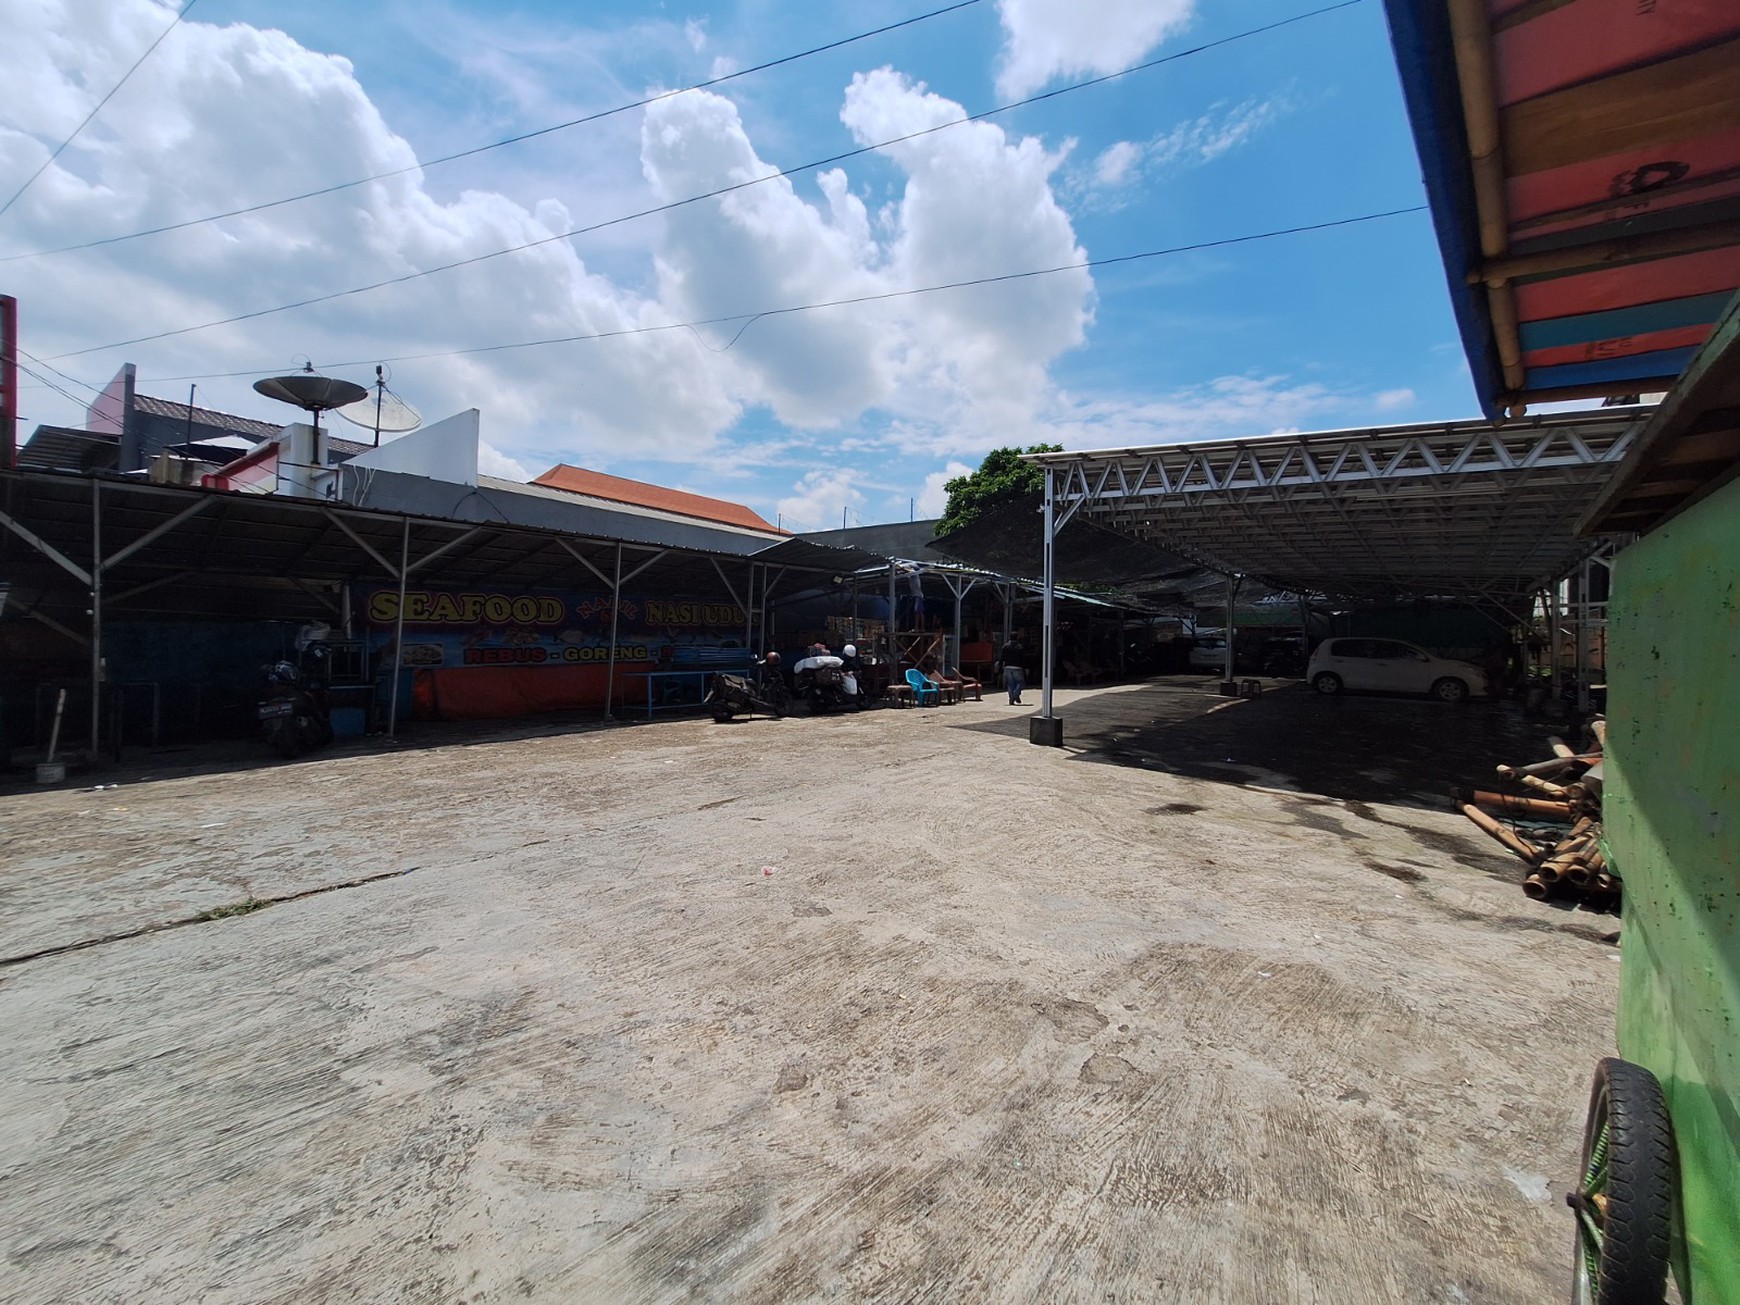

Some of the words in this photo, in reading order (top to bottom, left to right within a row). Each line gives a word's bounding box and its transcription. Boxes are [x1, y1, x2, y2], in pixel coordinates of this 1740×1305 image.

[369, 592, 564, 623] SEAFOOD
[646, 601, 700, 625] NASI
[463, 647, 547, 664] REBUS
[563, 646, 647, 661] GORENG
